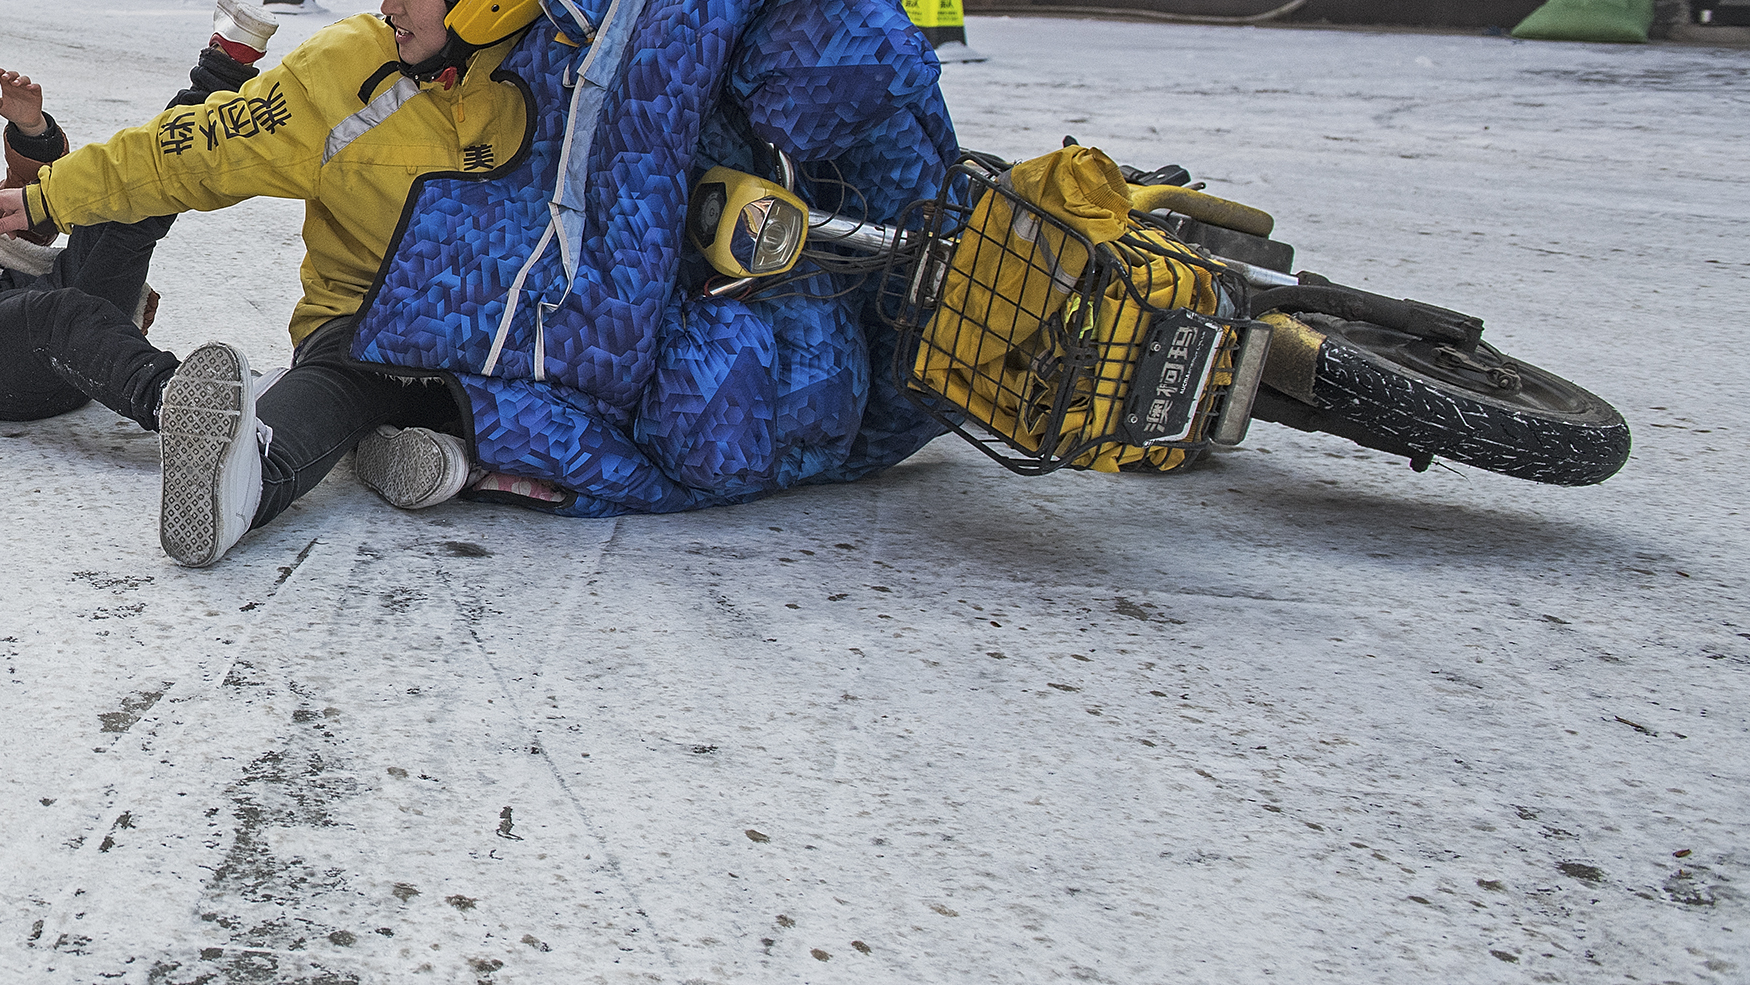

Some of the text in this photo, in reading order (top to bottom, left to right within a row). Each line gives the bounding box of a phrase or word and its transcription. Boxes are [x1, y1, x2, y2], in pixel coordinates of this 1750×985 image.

[463, 143, 494, 171] 美
[1143, 325, 1199, 433] 澳柯玛
